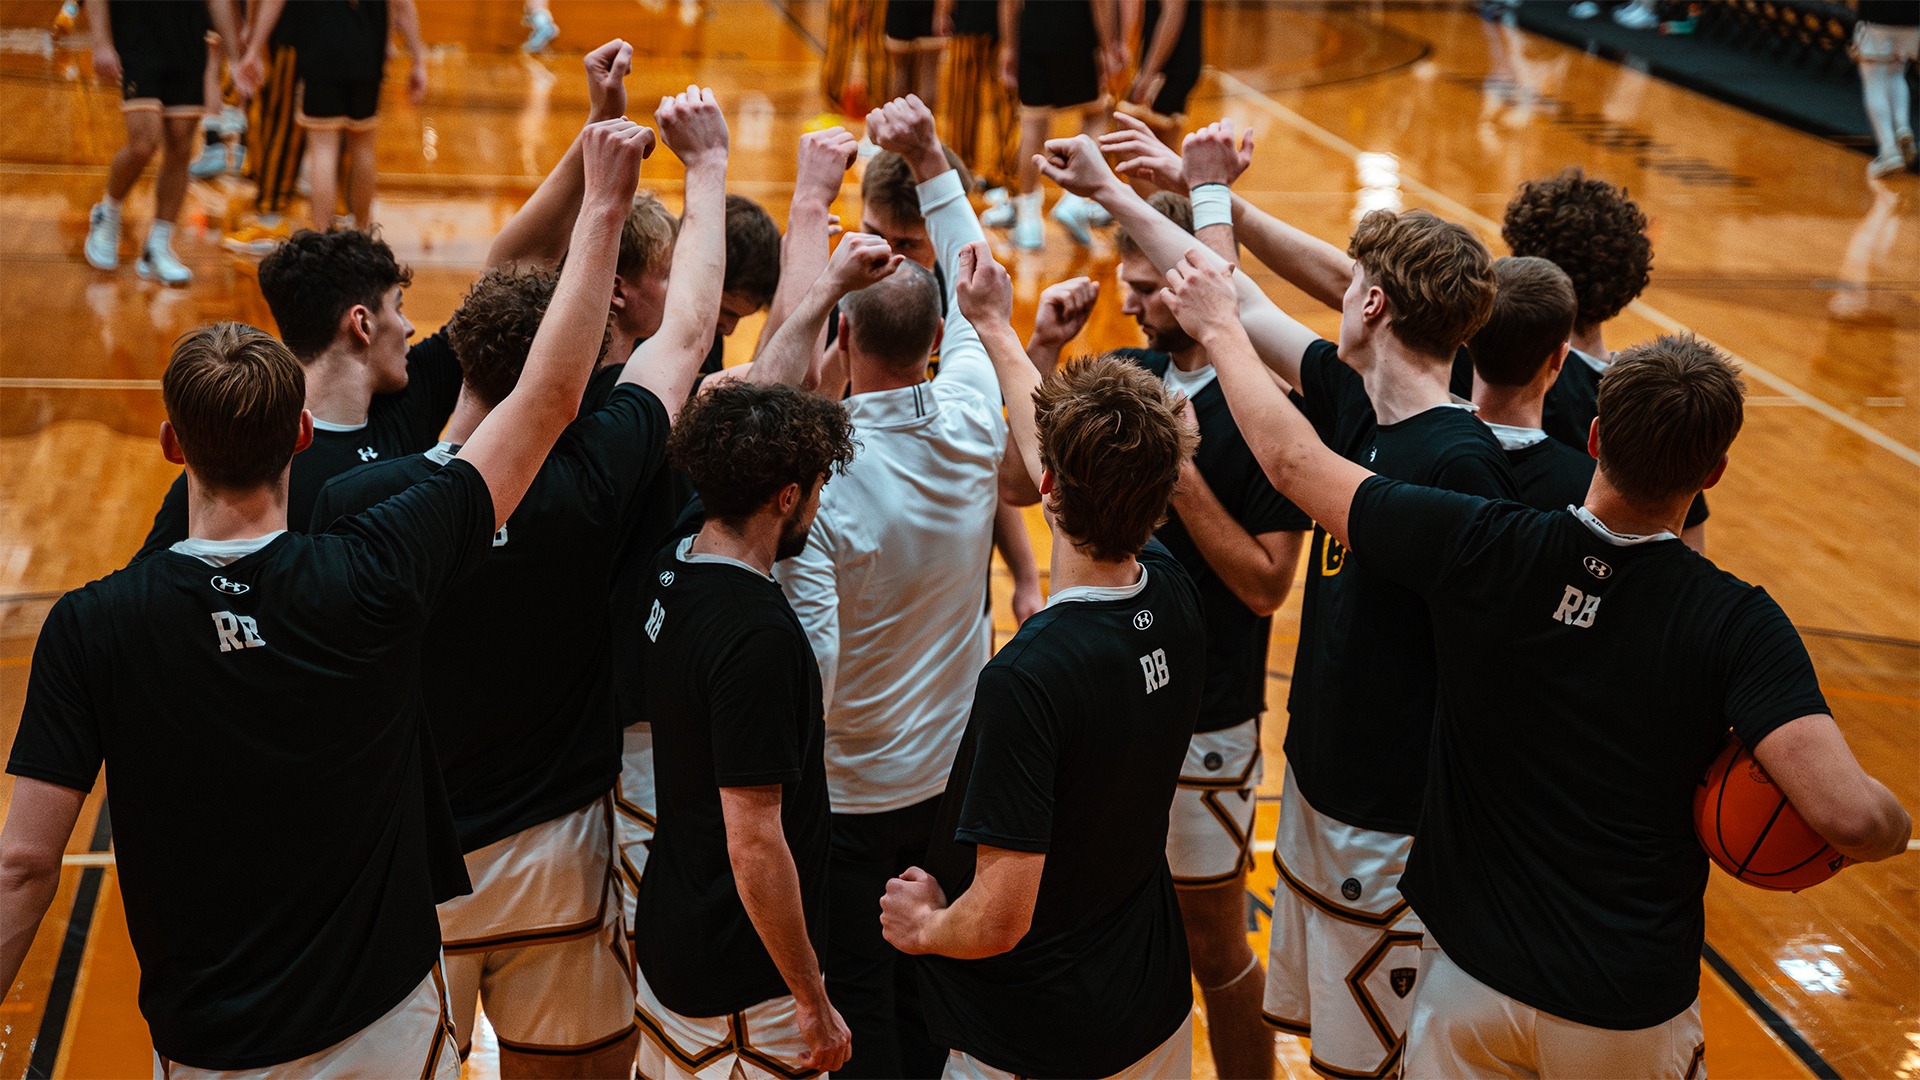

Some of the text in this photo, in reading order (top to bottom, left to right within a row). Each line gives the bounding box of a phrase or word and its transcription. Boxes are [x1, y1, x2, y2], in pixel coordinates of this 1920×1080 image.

[644, 598, 666, 644] RB
[1552, 584, 1602, 629] RB
[211, 610, 267, 653] RB
[1139, 647, 1171, 695] RB
